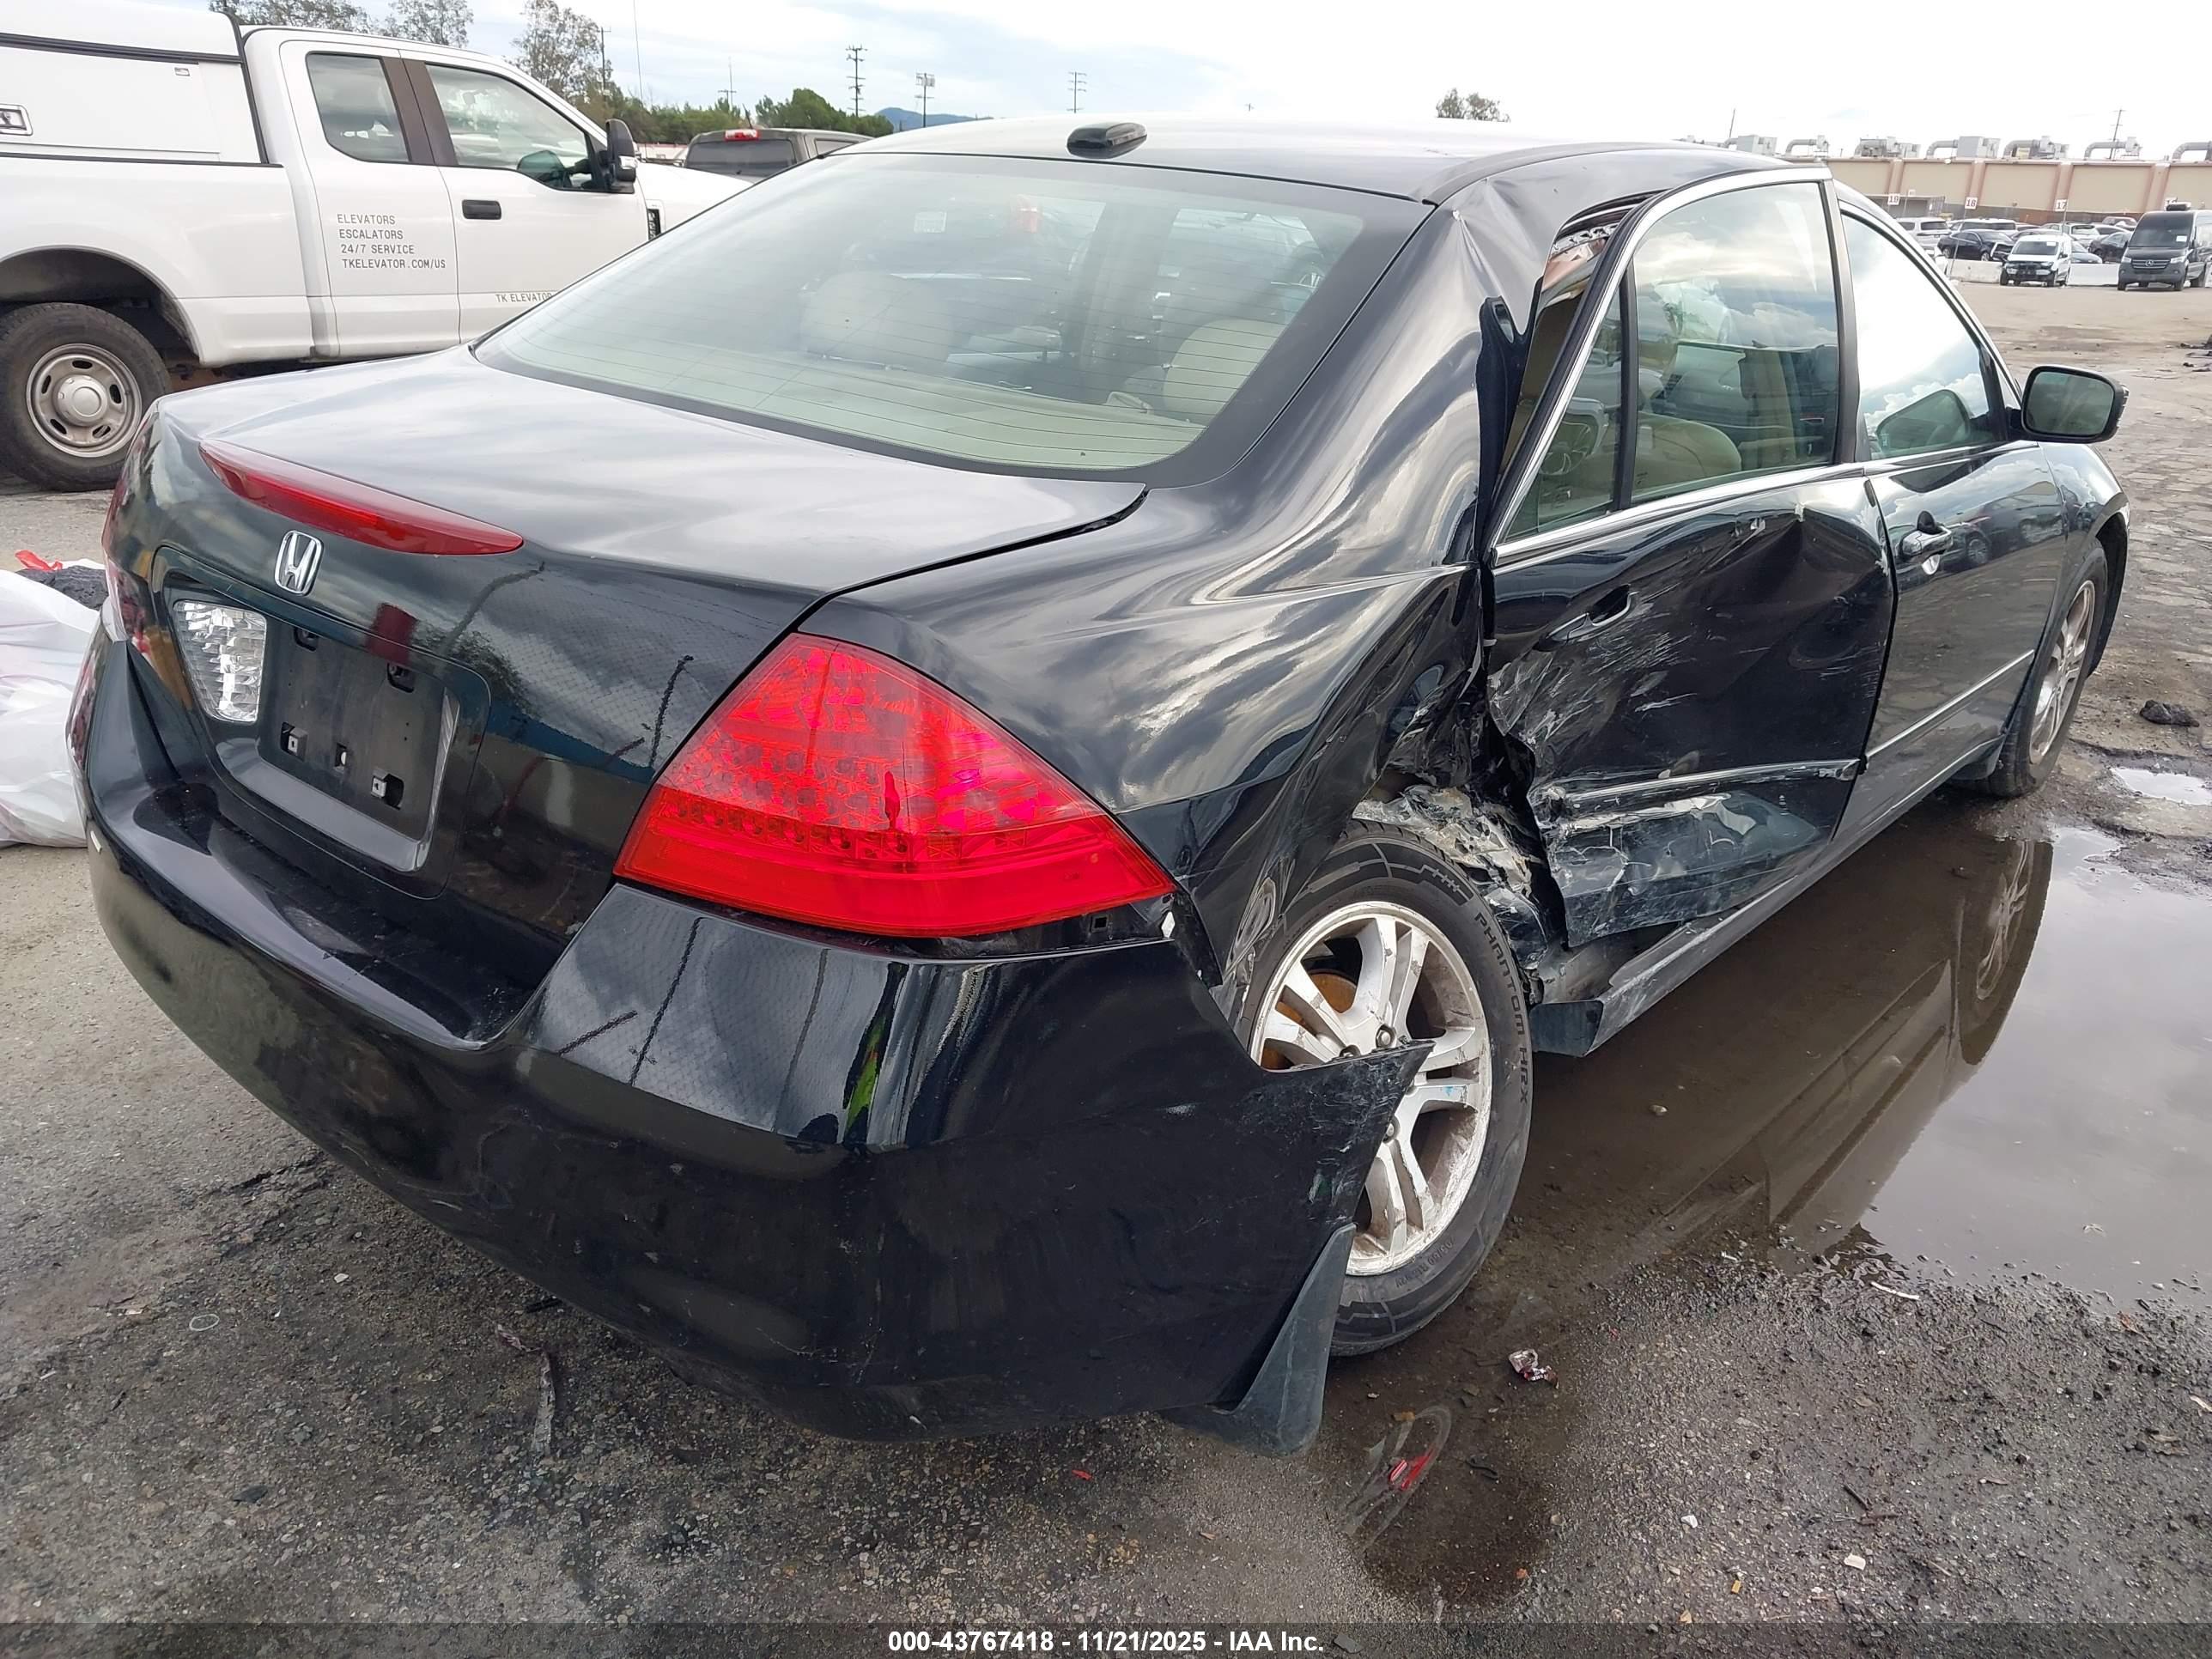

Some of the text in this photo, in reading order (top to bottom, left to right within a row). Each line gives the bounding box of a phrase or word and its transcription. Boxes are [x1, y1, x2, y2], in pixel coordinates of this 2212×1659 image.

[337, 214, 396, 225] ELEVATORS
[339, 229, 404, 240] ESCALATORS
[341, 244, 415, 254] 24/7 SERVICE
[342, 259, 446, 269] TKELEVATOR.COM/US
[495, 294, 507, 302] TK
[1474, 911, 1528, 1103] PHANTOM HRX
